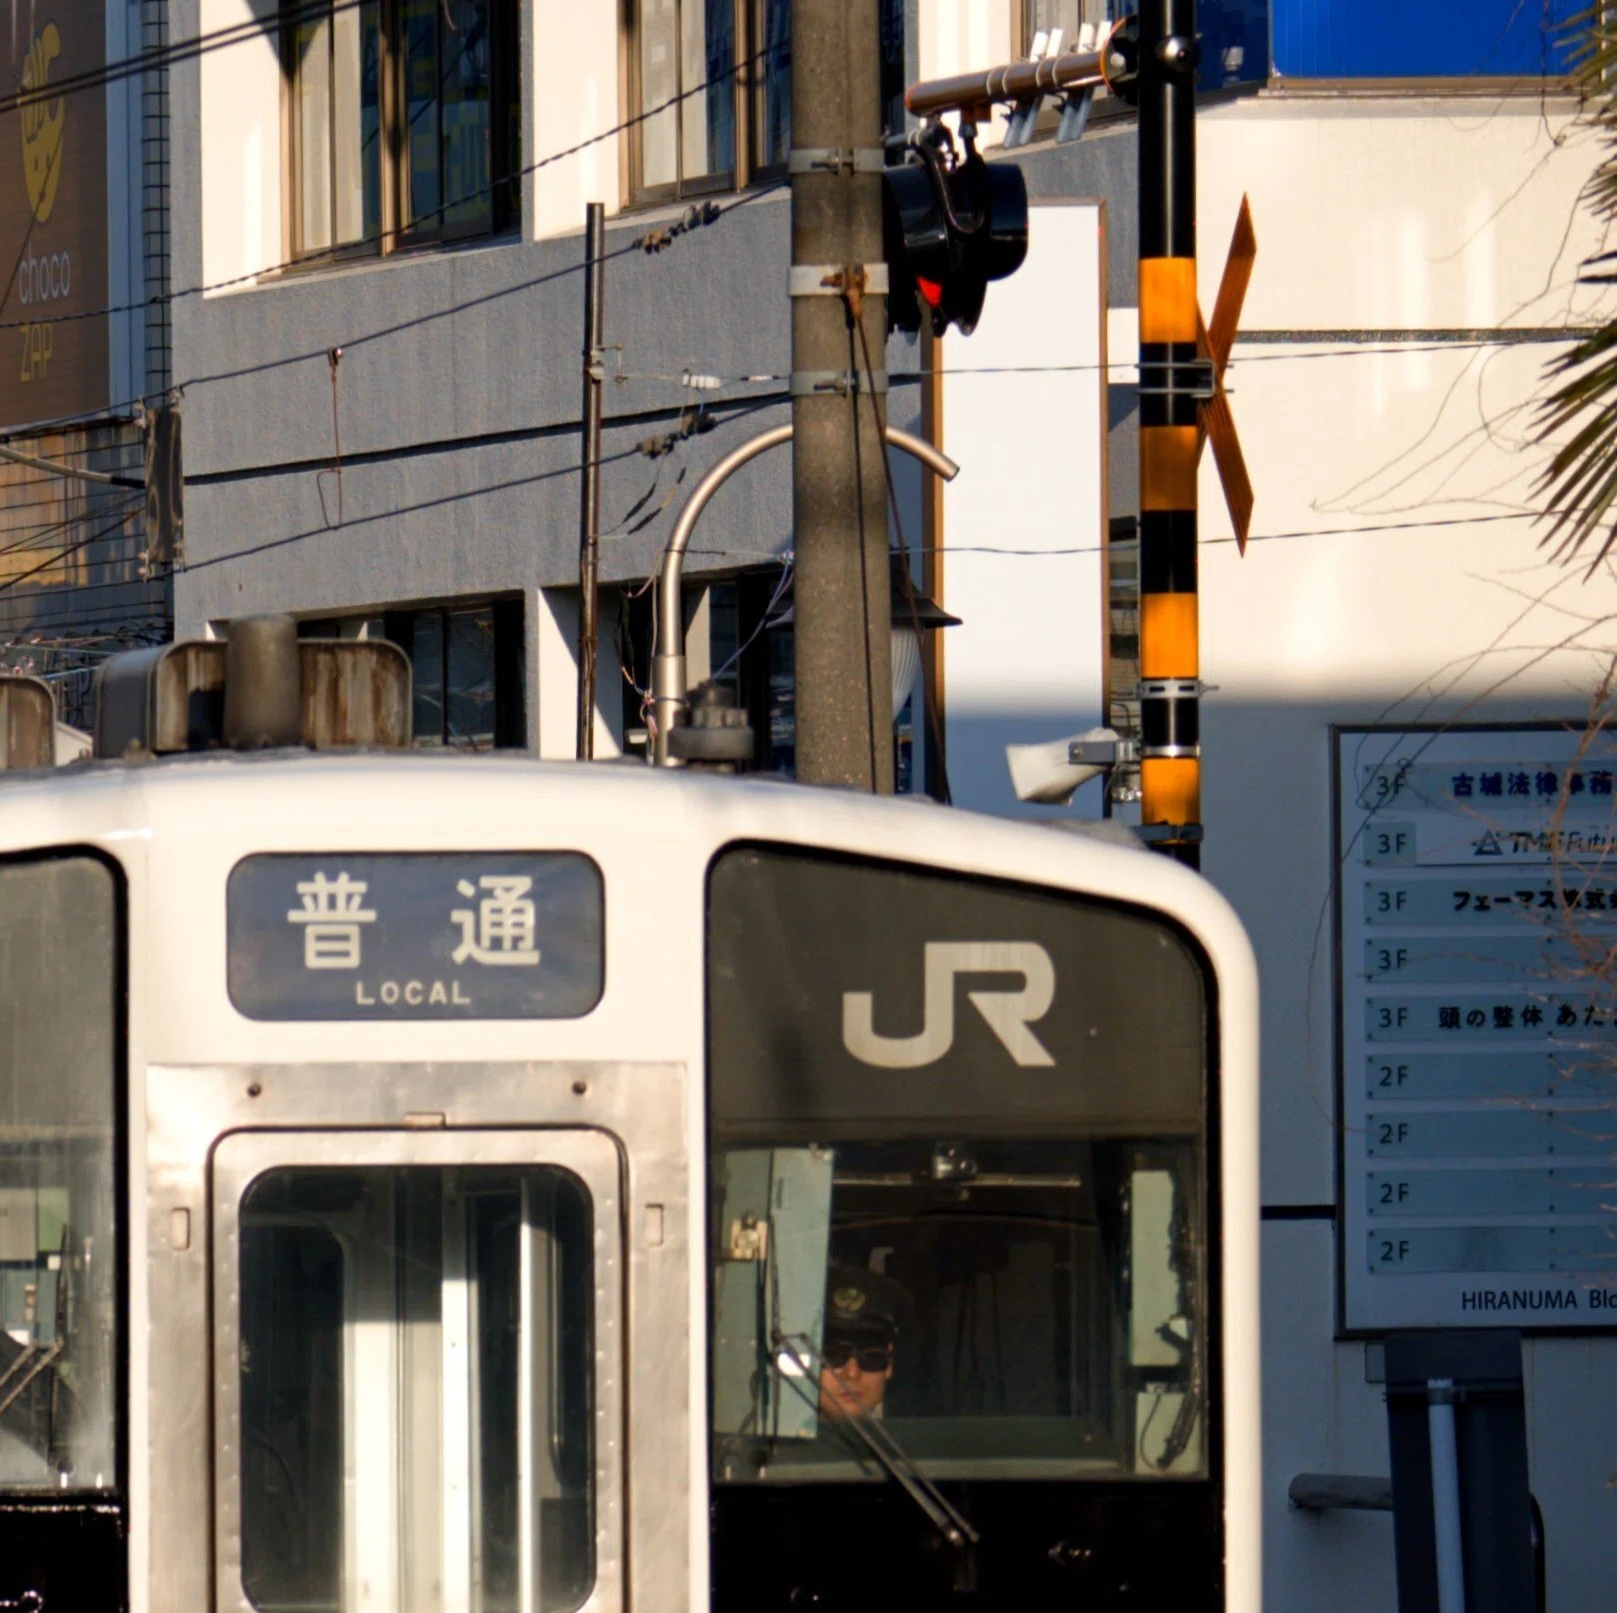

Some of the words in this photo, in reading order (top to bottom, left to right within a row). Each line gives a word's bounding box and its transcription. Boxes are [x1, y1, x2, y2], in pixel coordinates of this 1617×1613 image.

[19, 242, 70, 305] choco
[20, 323, 53, 382] ZAP
[1377, 775, 1405, 796] 3F
[1378, 833, 1407, 854] 3F
[1378, 891, 1407, 912] 3F
[287, 871, 541, 969] 普通
[1379, 949, 1407, 969] 3F
[355, 981, 472, 1006] LOCAL
[842, 941, 1056, 1068] JR
[1379, 1007, 1407, 1028] 3F
[1557, 1004, 1617, 1027] あた
[1379, 1065, 1408, 1087] 2F
[1379, 1123, 1408, 1144] 2F
[1380, 1183, 1409, 1204] 2F
[1380, 1240, 1410, 1261] 2F
[1461, 1290, 1578, 1310] HIRANUMA
